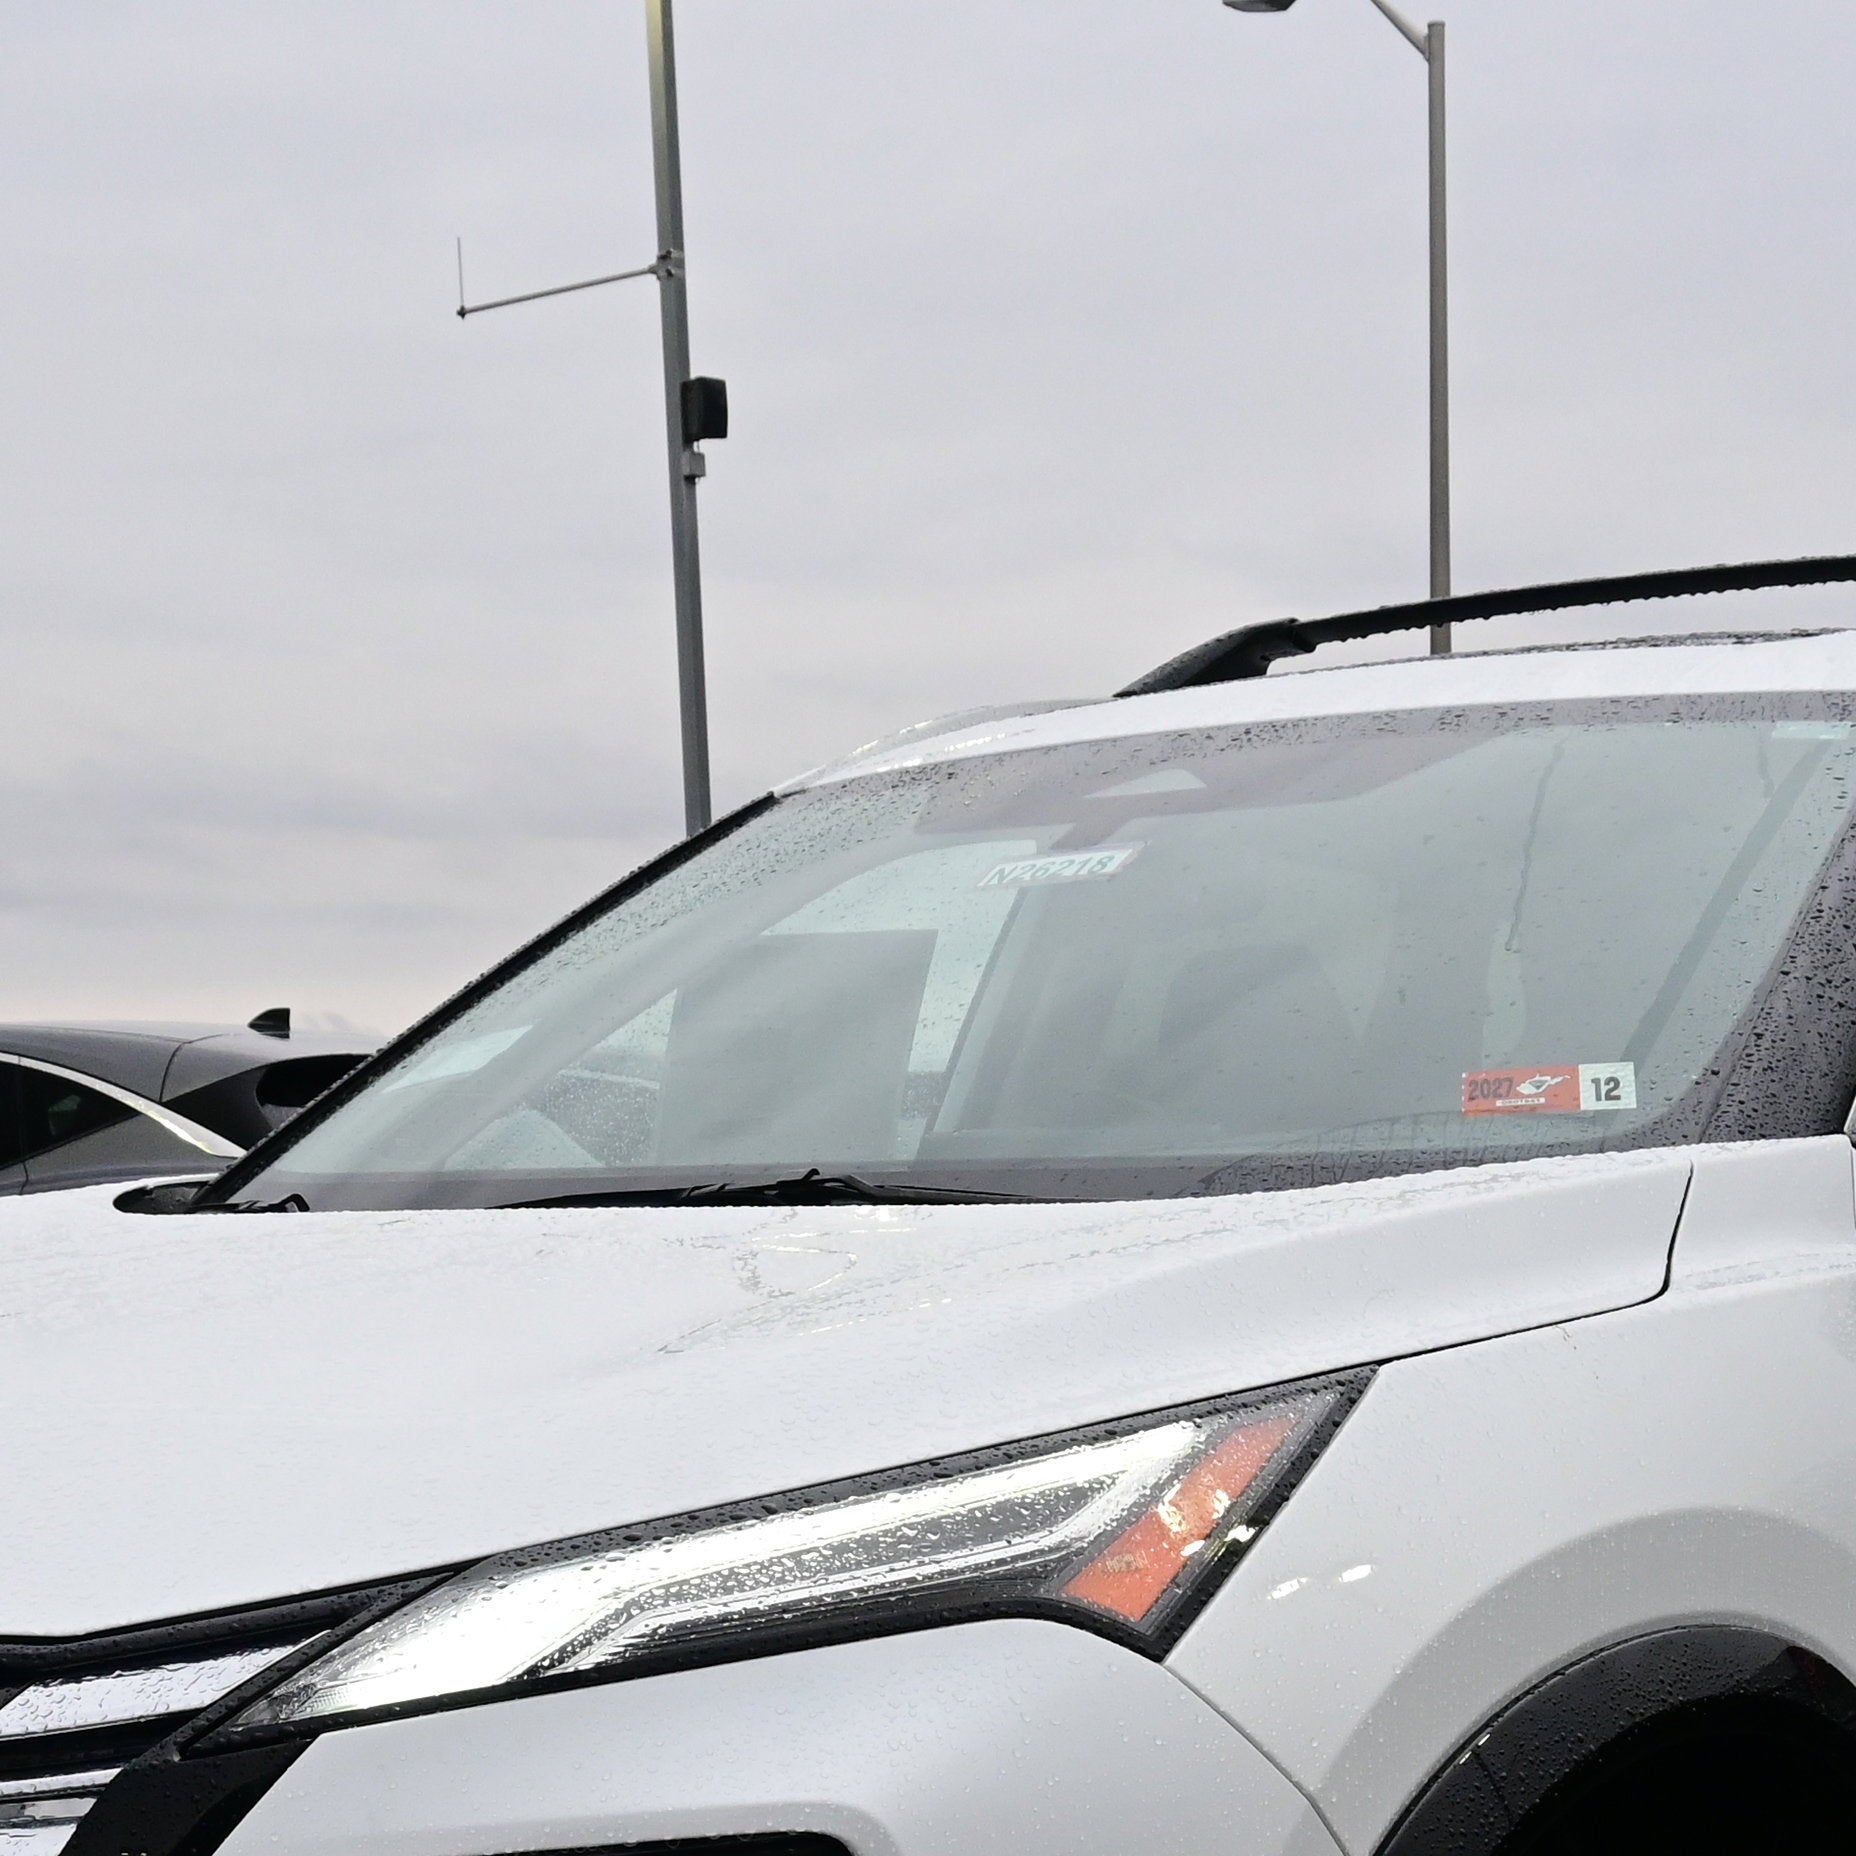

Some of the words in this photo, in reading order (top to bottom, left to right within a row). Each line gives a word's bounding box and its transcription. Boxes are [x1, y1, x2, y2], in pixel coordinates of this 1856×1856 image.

[986, 854, 1116, 885] N26218
[1467, 1077, 1514, 1102] 2027
[1591, 1076, 1622, 1102] 12
